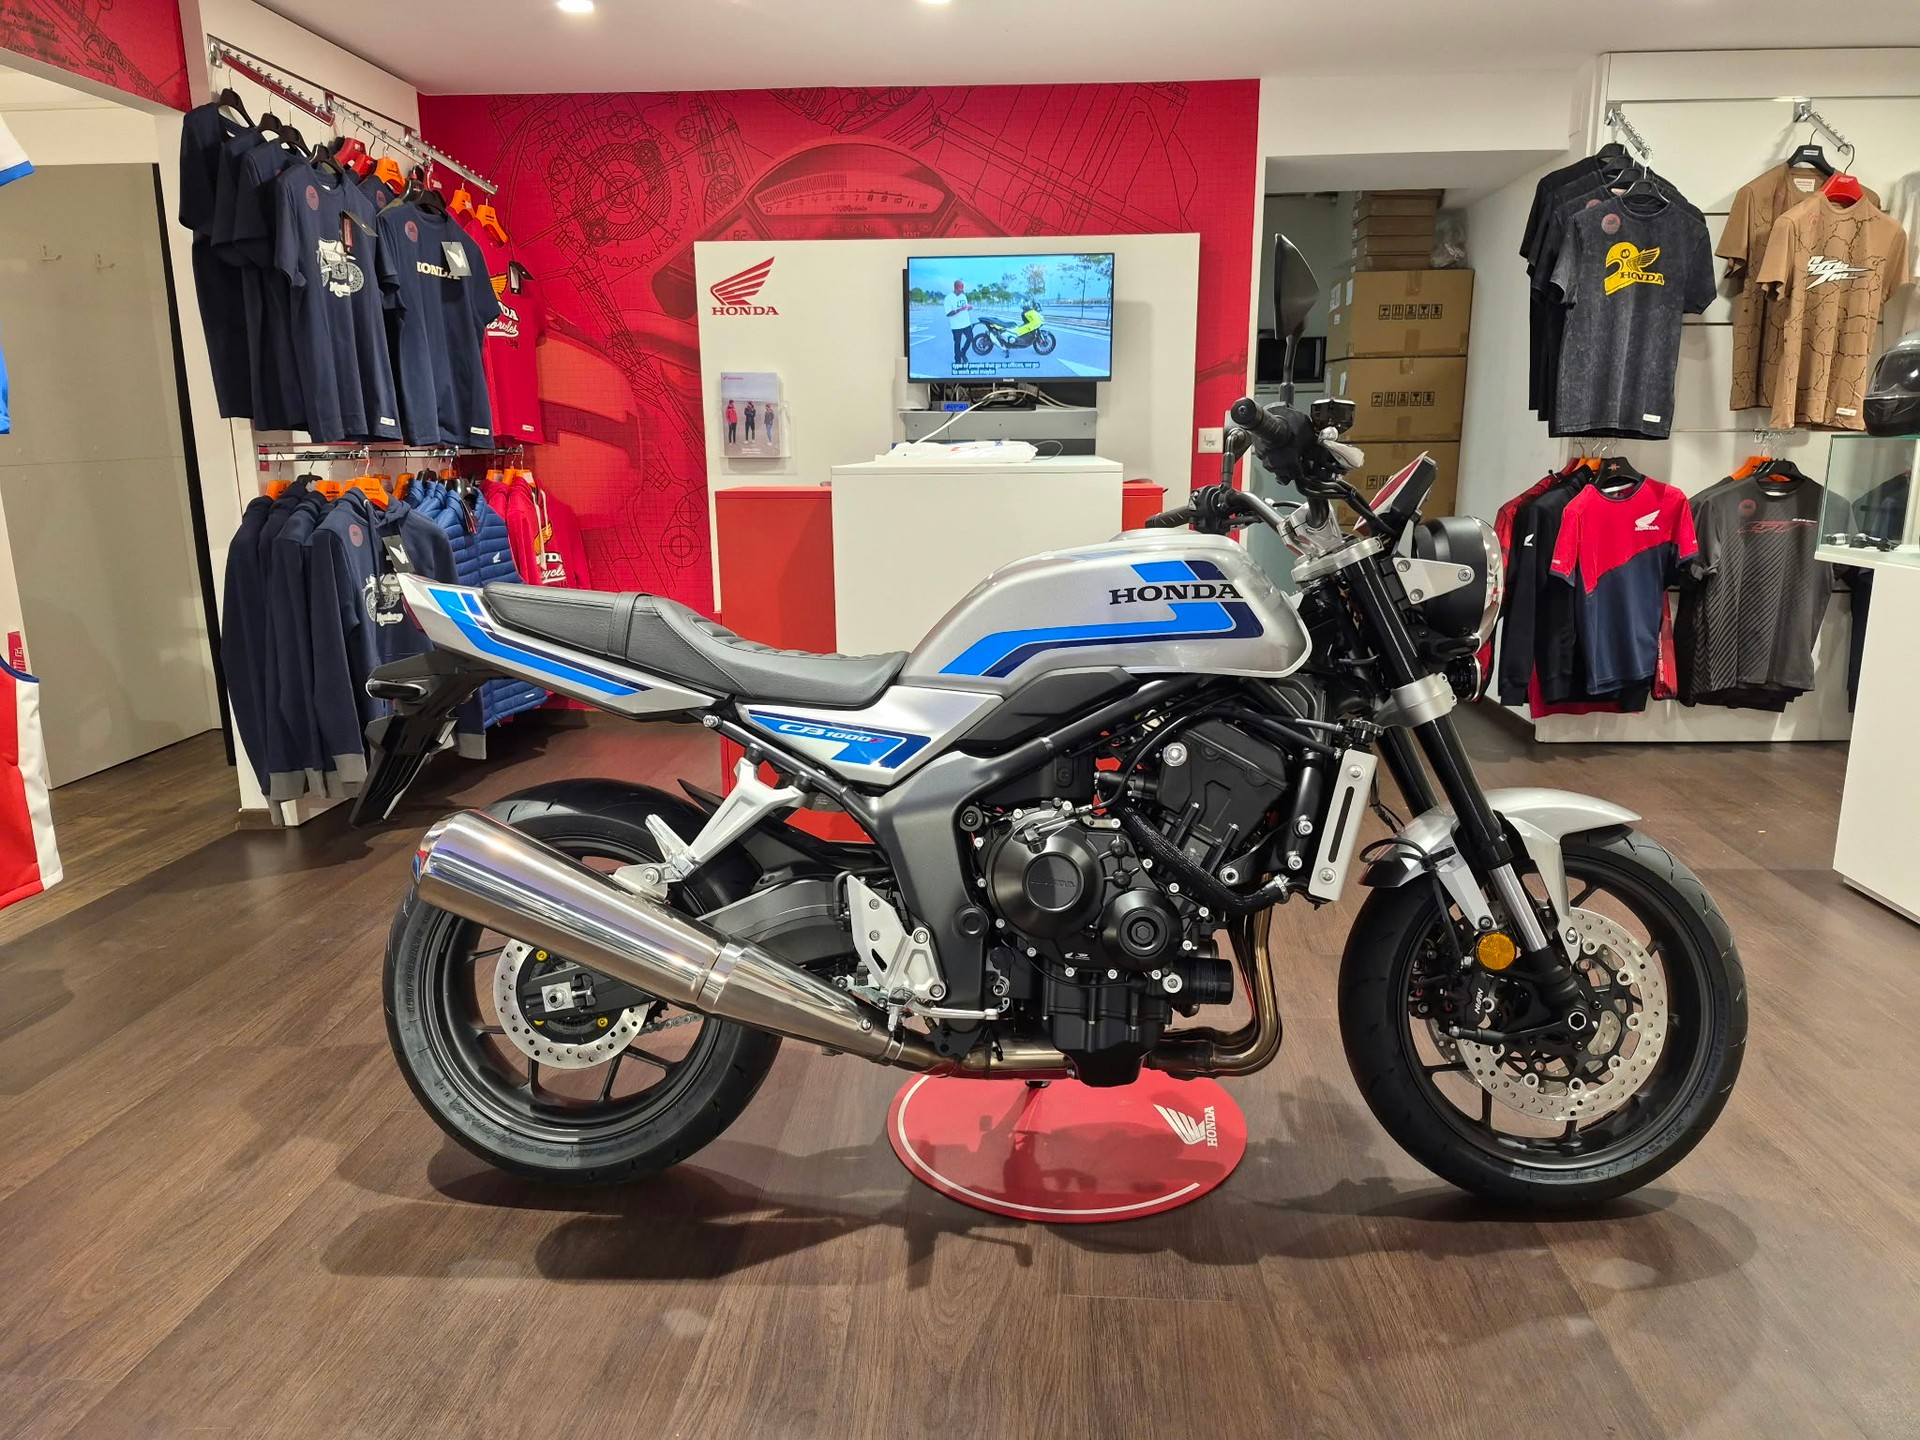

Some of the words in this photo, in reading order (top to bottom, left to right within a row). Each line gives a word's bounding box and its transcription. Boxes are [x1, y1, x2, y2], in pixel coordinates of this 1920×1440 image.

[1620, 271, 1665, 284] HONDA
[711, 306, 780, 316] HONDA
[1108, 583, 1243, 605] HONDA
[778, 723, 886, 744] CB1000F
[1204, 1105, 1218, 1148] HONDA
